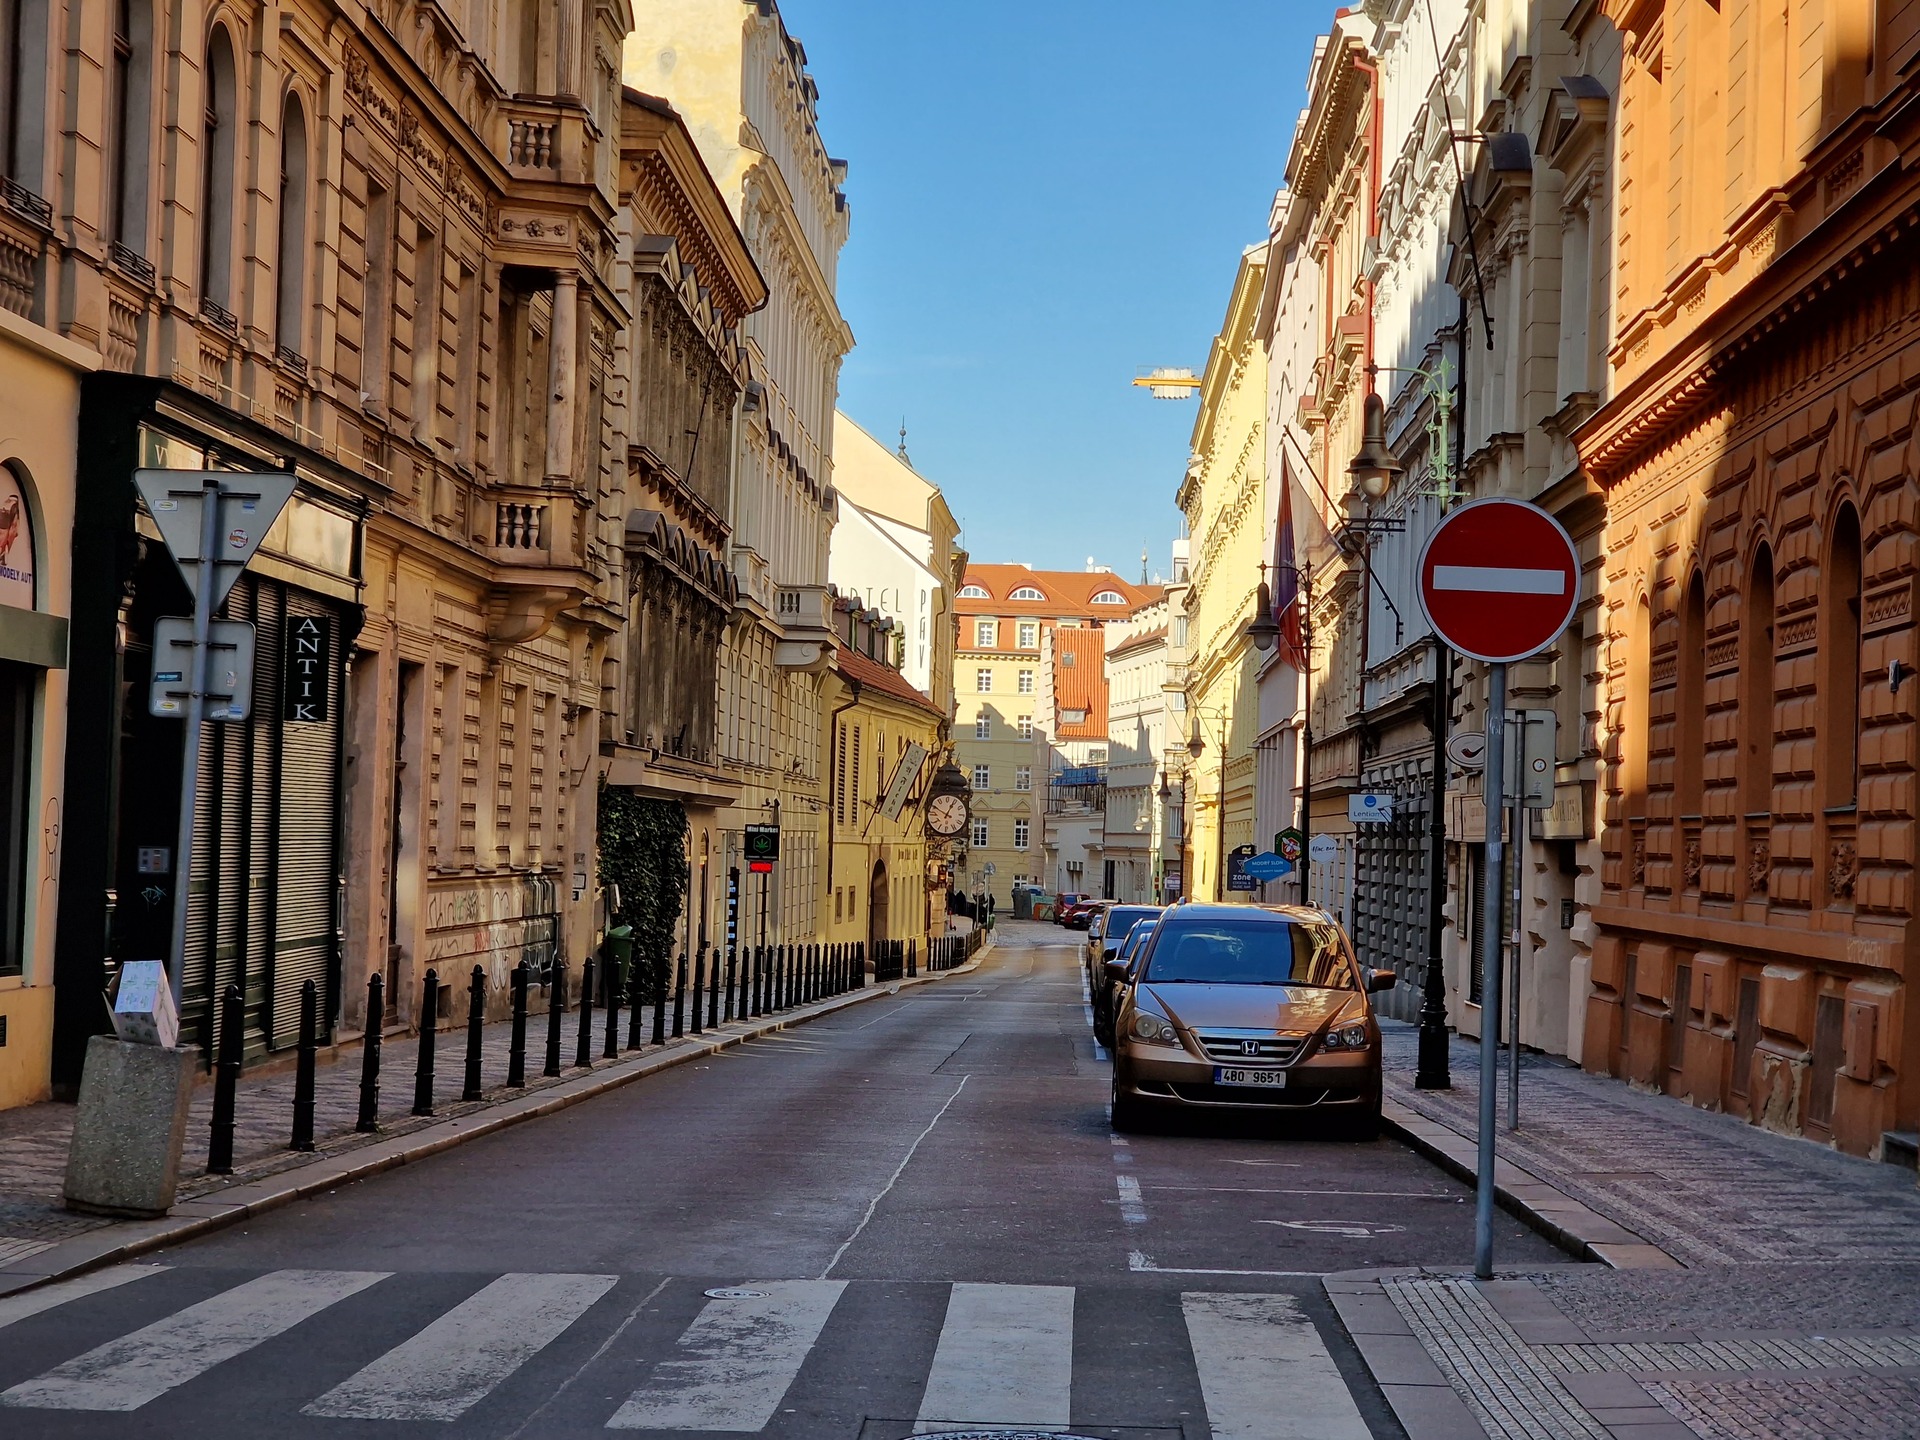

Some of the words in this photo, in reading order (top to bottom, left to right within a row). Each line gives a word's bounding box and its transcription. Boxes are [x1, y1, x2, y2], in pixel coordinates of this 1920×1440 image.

[294, 618, 320, 721] ANTIK
[1223, 1070, 1244, 1082] 4B0
[1253, 1072, 1281, 1084] 9651
